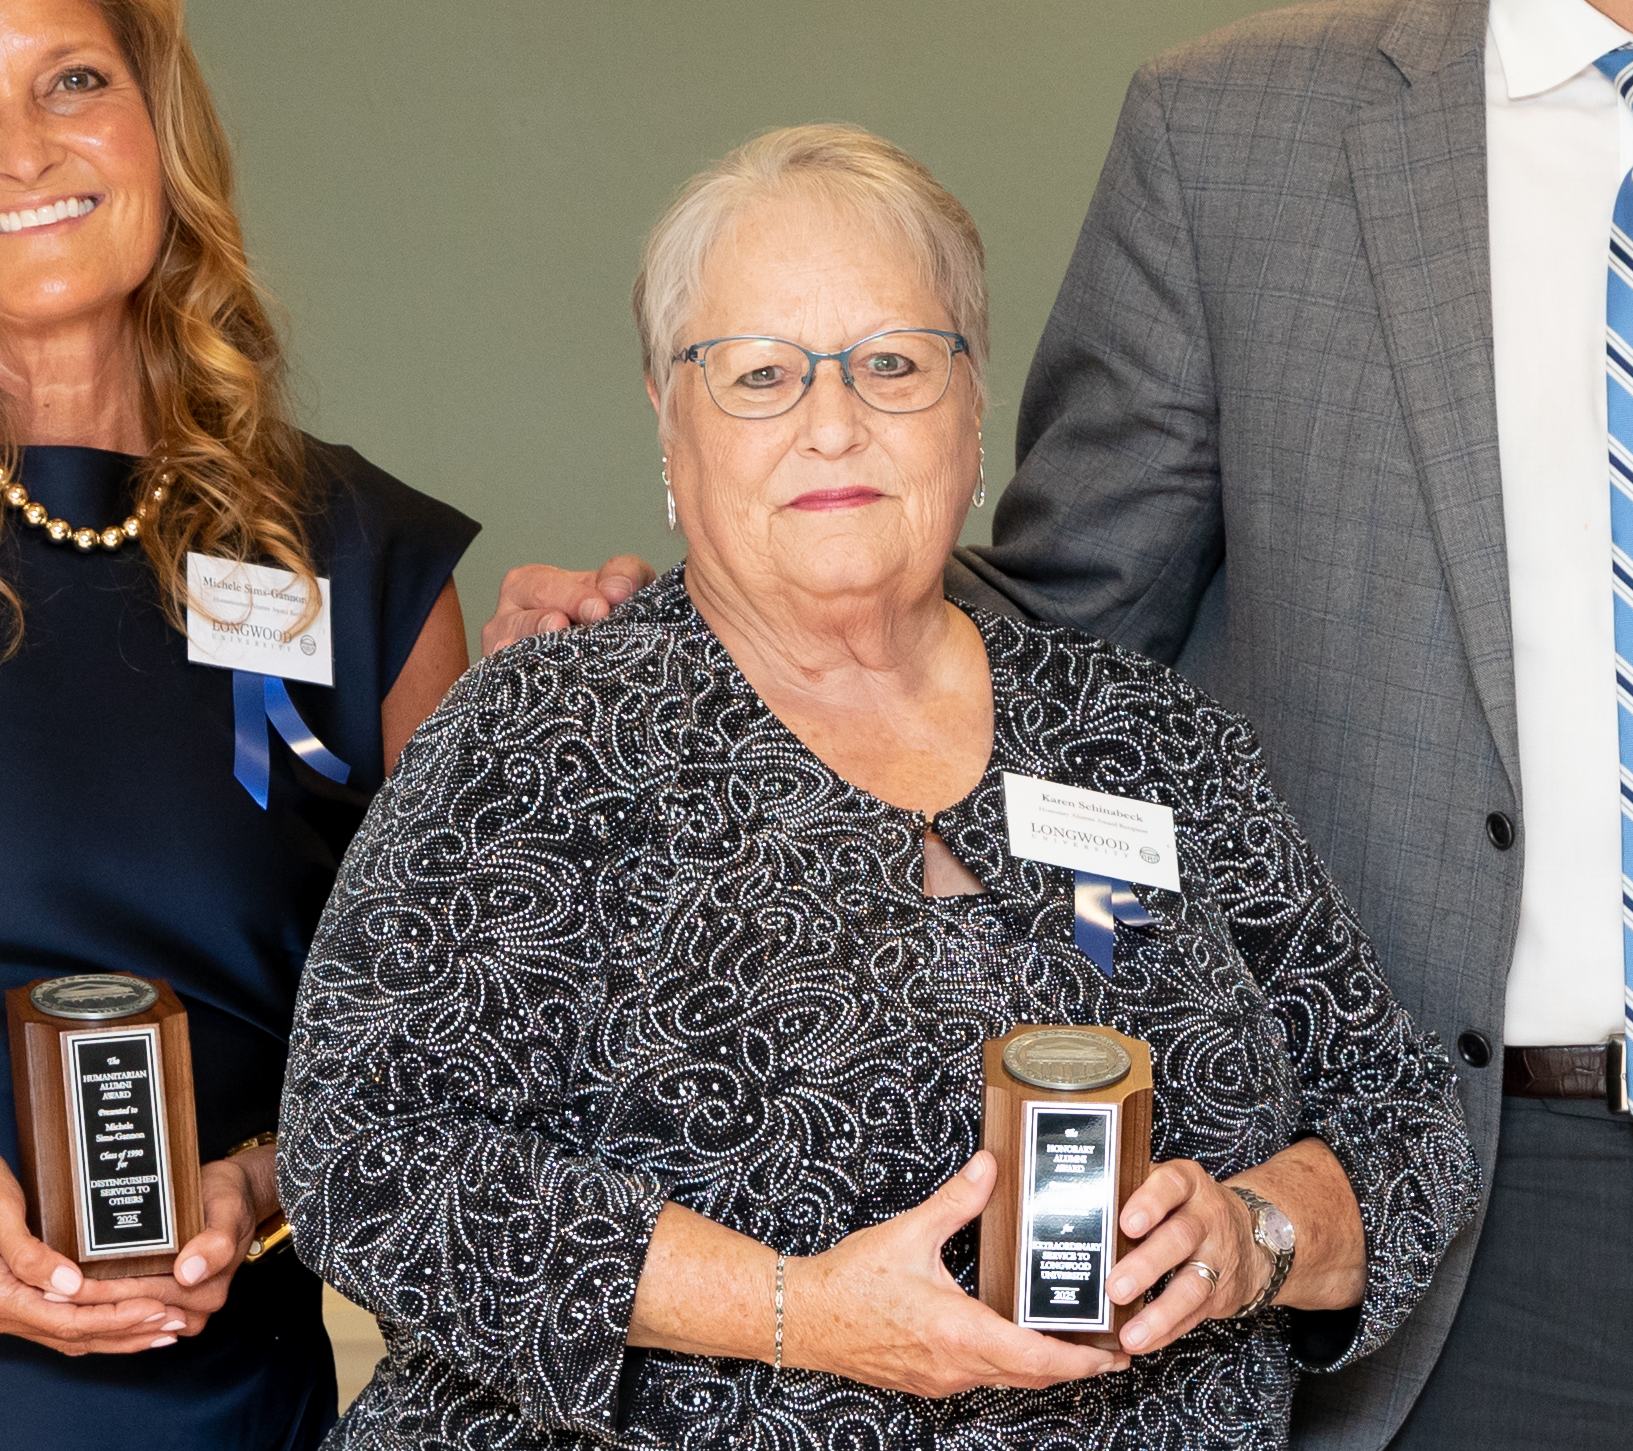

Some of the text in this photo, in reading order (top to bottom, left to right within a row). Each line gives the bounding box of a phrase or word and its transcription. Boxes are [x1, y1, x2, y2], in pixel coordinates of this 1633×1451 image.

[203, 576, 242, 592] Michele
[212, 619, 292, 644] LONGWOOD
[212, 633, 290, 652] UNIVERSITY
[1041, 793, 1144, 822] Karen Schinabeck
[1031, 822, 1129, 851] LONGWOOD
[1031, 833, 1128, 858] UNIVERSITY
[82, 1070, 147, 1083] HUMANITARIAN
[99, 1081, 132, 1091] ALUMNI
[102, 1091, 131, 1100] AWARD
[105, 1122, 134, 1132] Michele
[1046, 1144, 1096, 1154] HONORARY
[99, 1151, 118, 1161] Class
[118, 1149, 127, 1162] of
[115, 1160, 128, 1170] for
[90, 1175, 158, 1188] DISTINGUISHED
[100, 1185, 150, 1197] SERVICE TO
[108, 1195, 144, 1206] OTHERS
[117, 1214, 139, 1225] 2025
[1032, 1241, 1102, 1252] EXTRAORDINARY
[1042, 1251, 1091, 1261] SERVICE TO
[1040, 1260, 1092, 1271] LONGWOOD
[1040, 1270, 1091, 1281] UNIVERSITY
[1053, 1290, 1076, 1301] 2025
